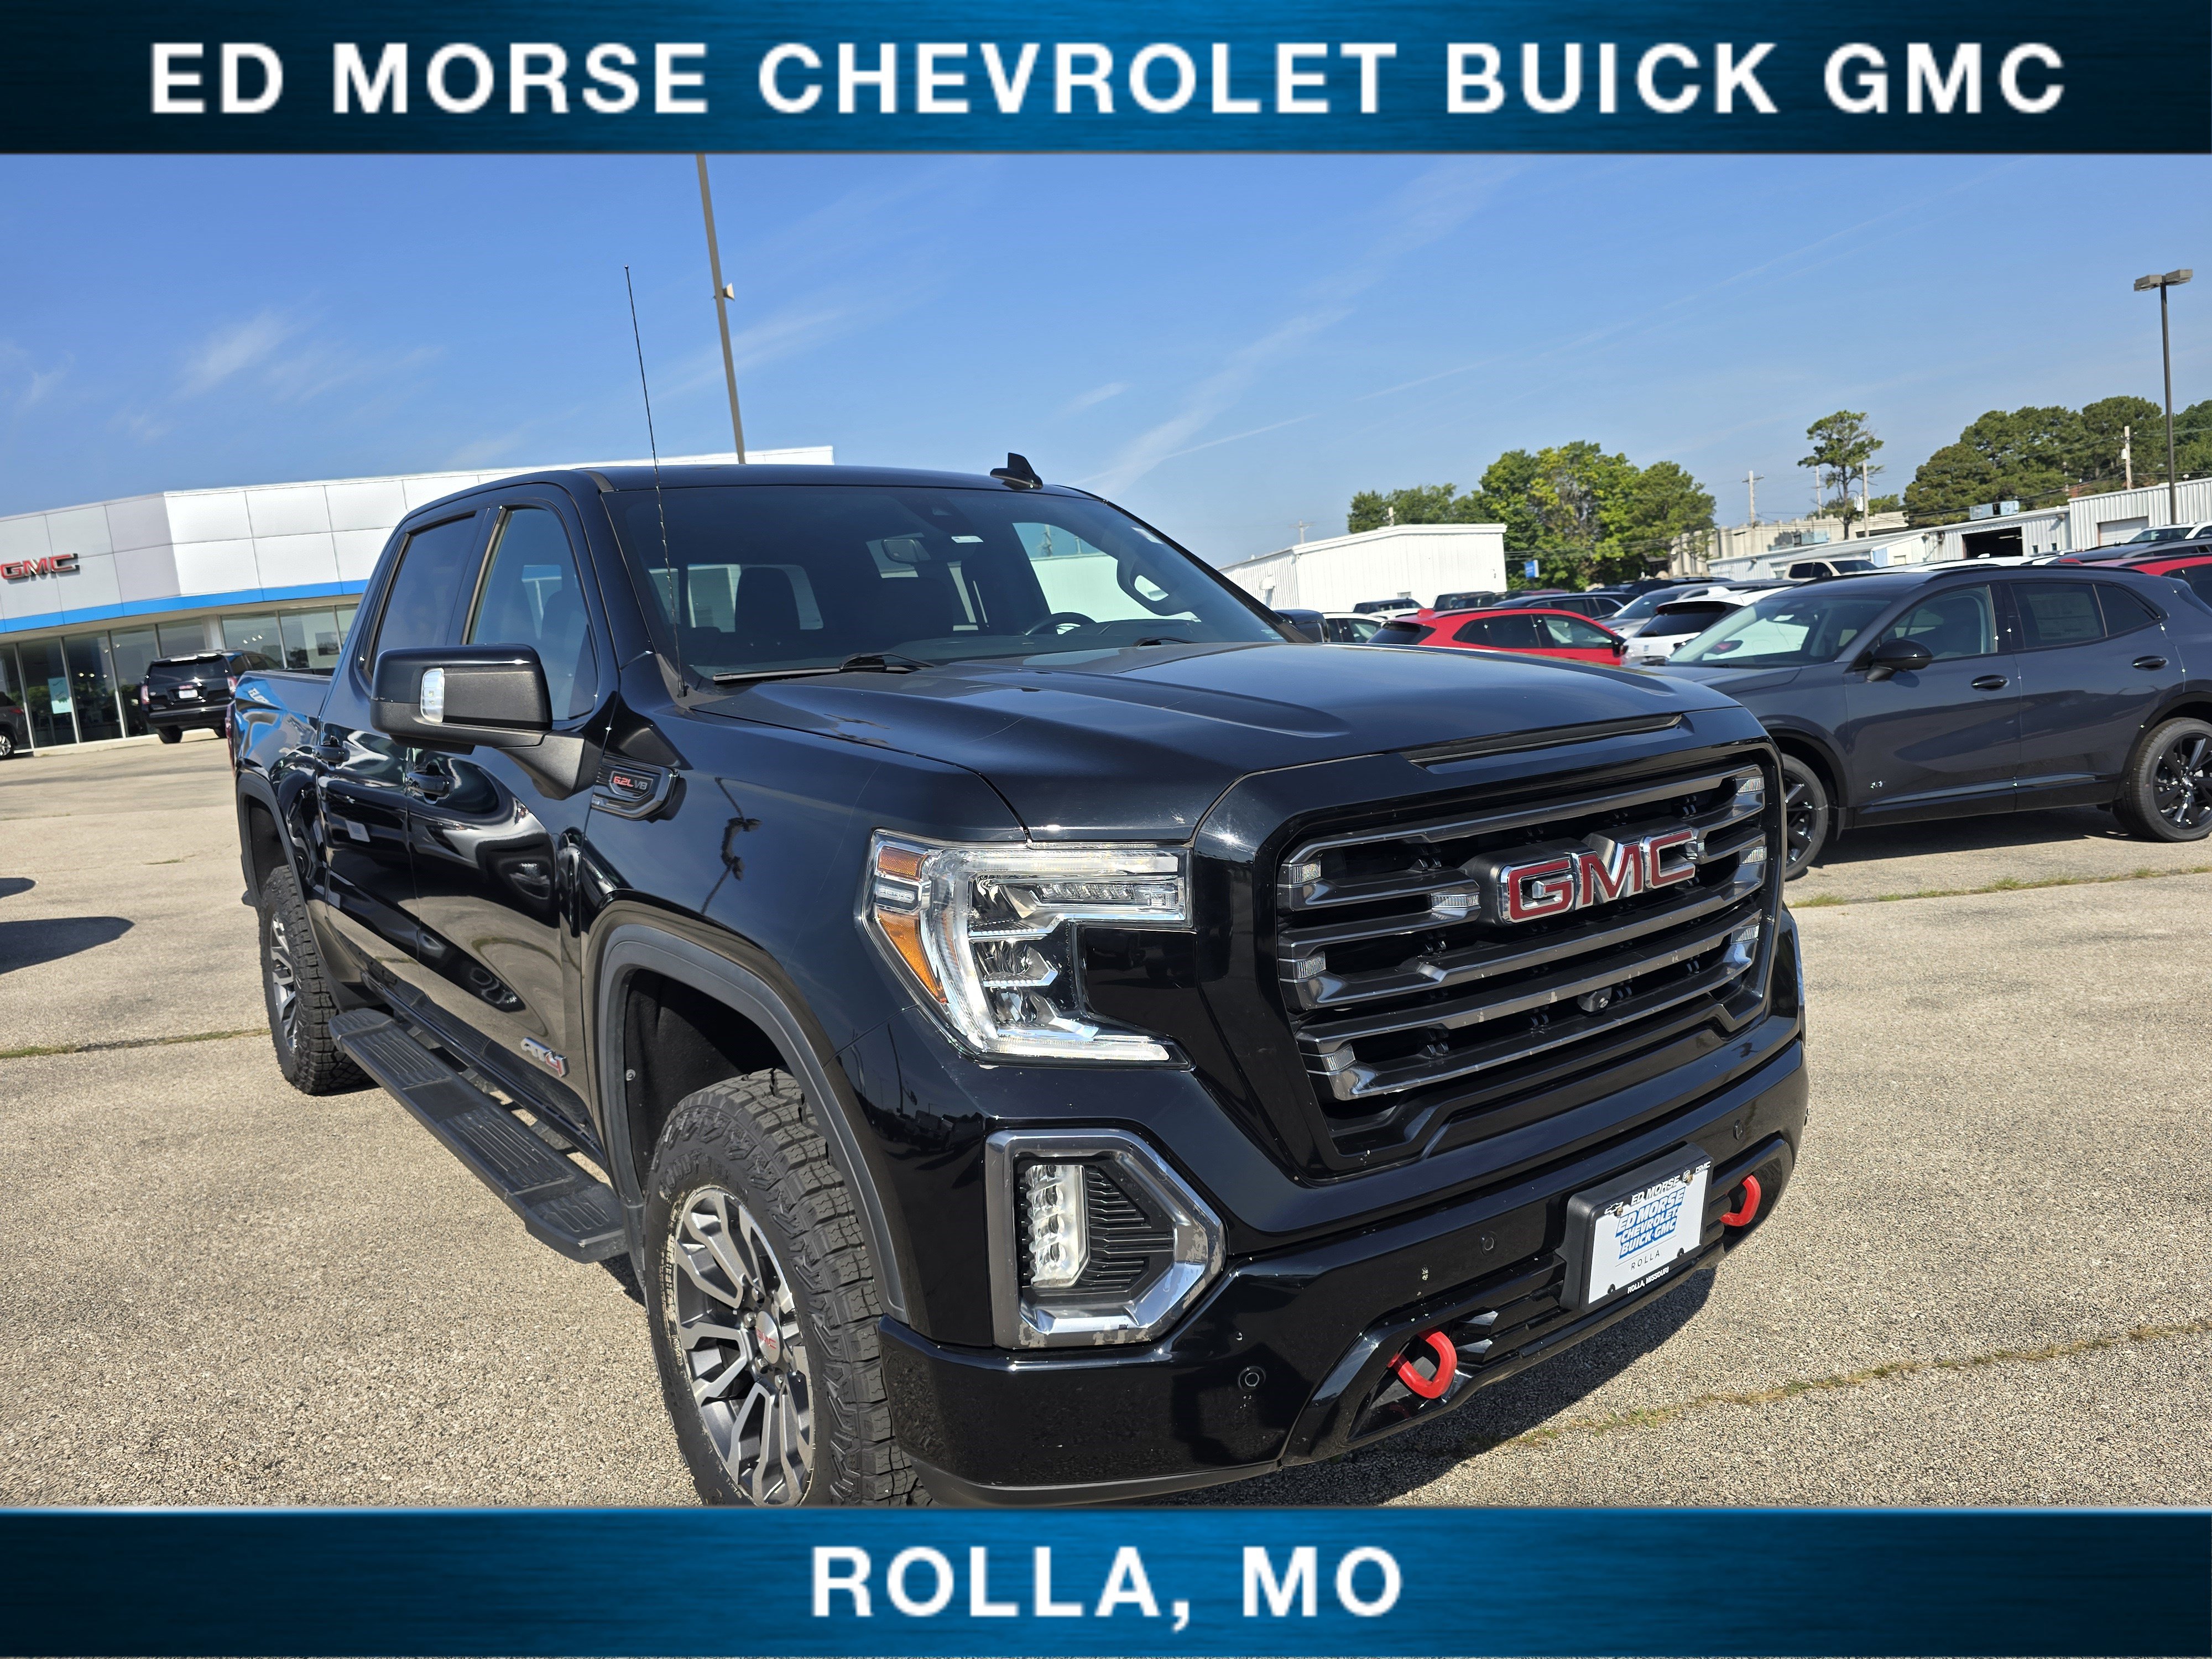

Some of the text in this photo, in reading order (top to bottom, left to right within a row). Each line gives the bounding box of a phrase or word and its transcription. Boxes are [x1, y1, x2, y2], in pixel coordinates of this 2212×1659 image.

[0, 554, 77, 580] GMC
[634, 780, 648, 790] V8
[1498, 828, 1698, 925] GMC
[1695, 1161, 1711, 1173] GMC
[1631, 1175, 1681, 1206] ED MORSE
[1615, 1187, 1685, 1237] ED MORSE
[1620, 1206, 1678, 1244] CHEVROLET
[1619, 1217, 1677, 1258] BUICK GMC
[1631, 1249, 1660, 1271] ROLLA
[1646, 1266, 1670, 1285] MISSOURI
